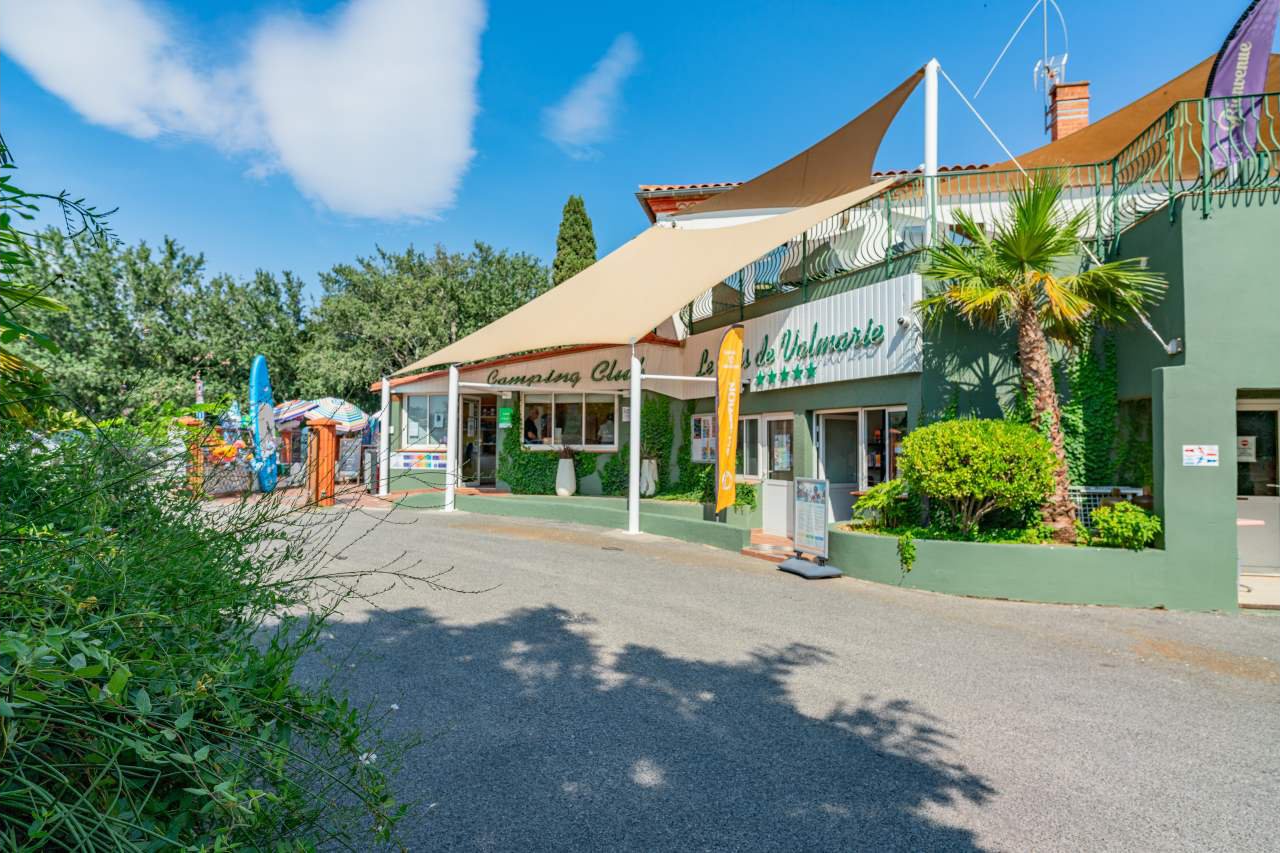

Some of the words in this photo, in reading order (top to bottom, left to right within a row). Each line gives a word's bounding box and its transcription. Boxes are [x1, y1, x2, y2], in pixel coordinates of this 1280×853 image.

[695, 349, 714, 377] Le
[755, 334, 775, 367] de
[781, 318, 885, 361] Valmarie
[487, 369, 582, 389] Camping
